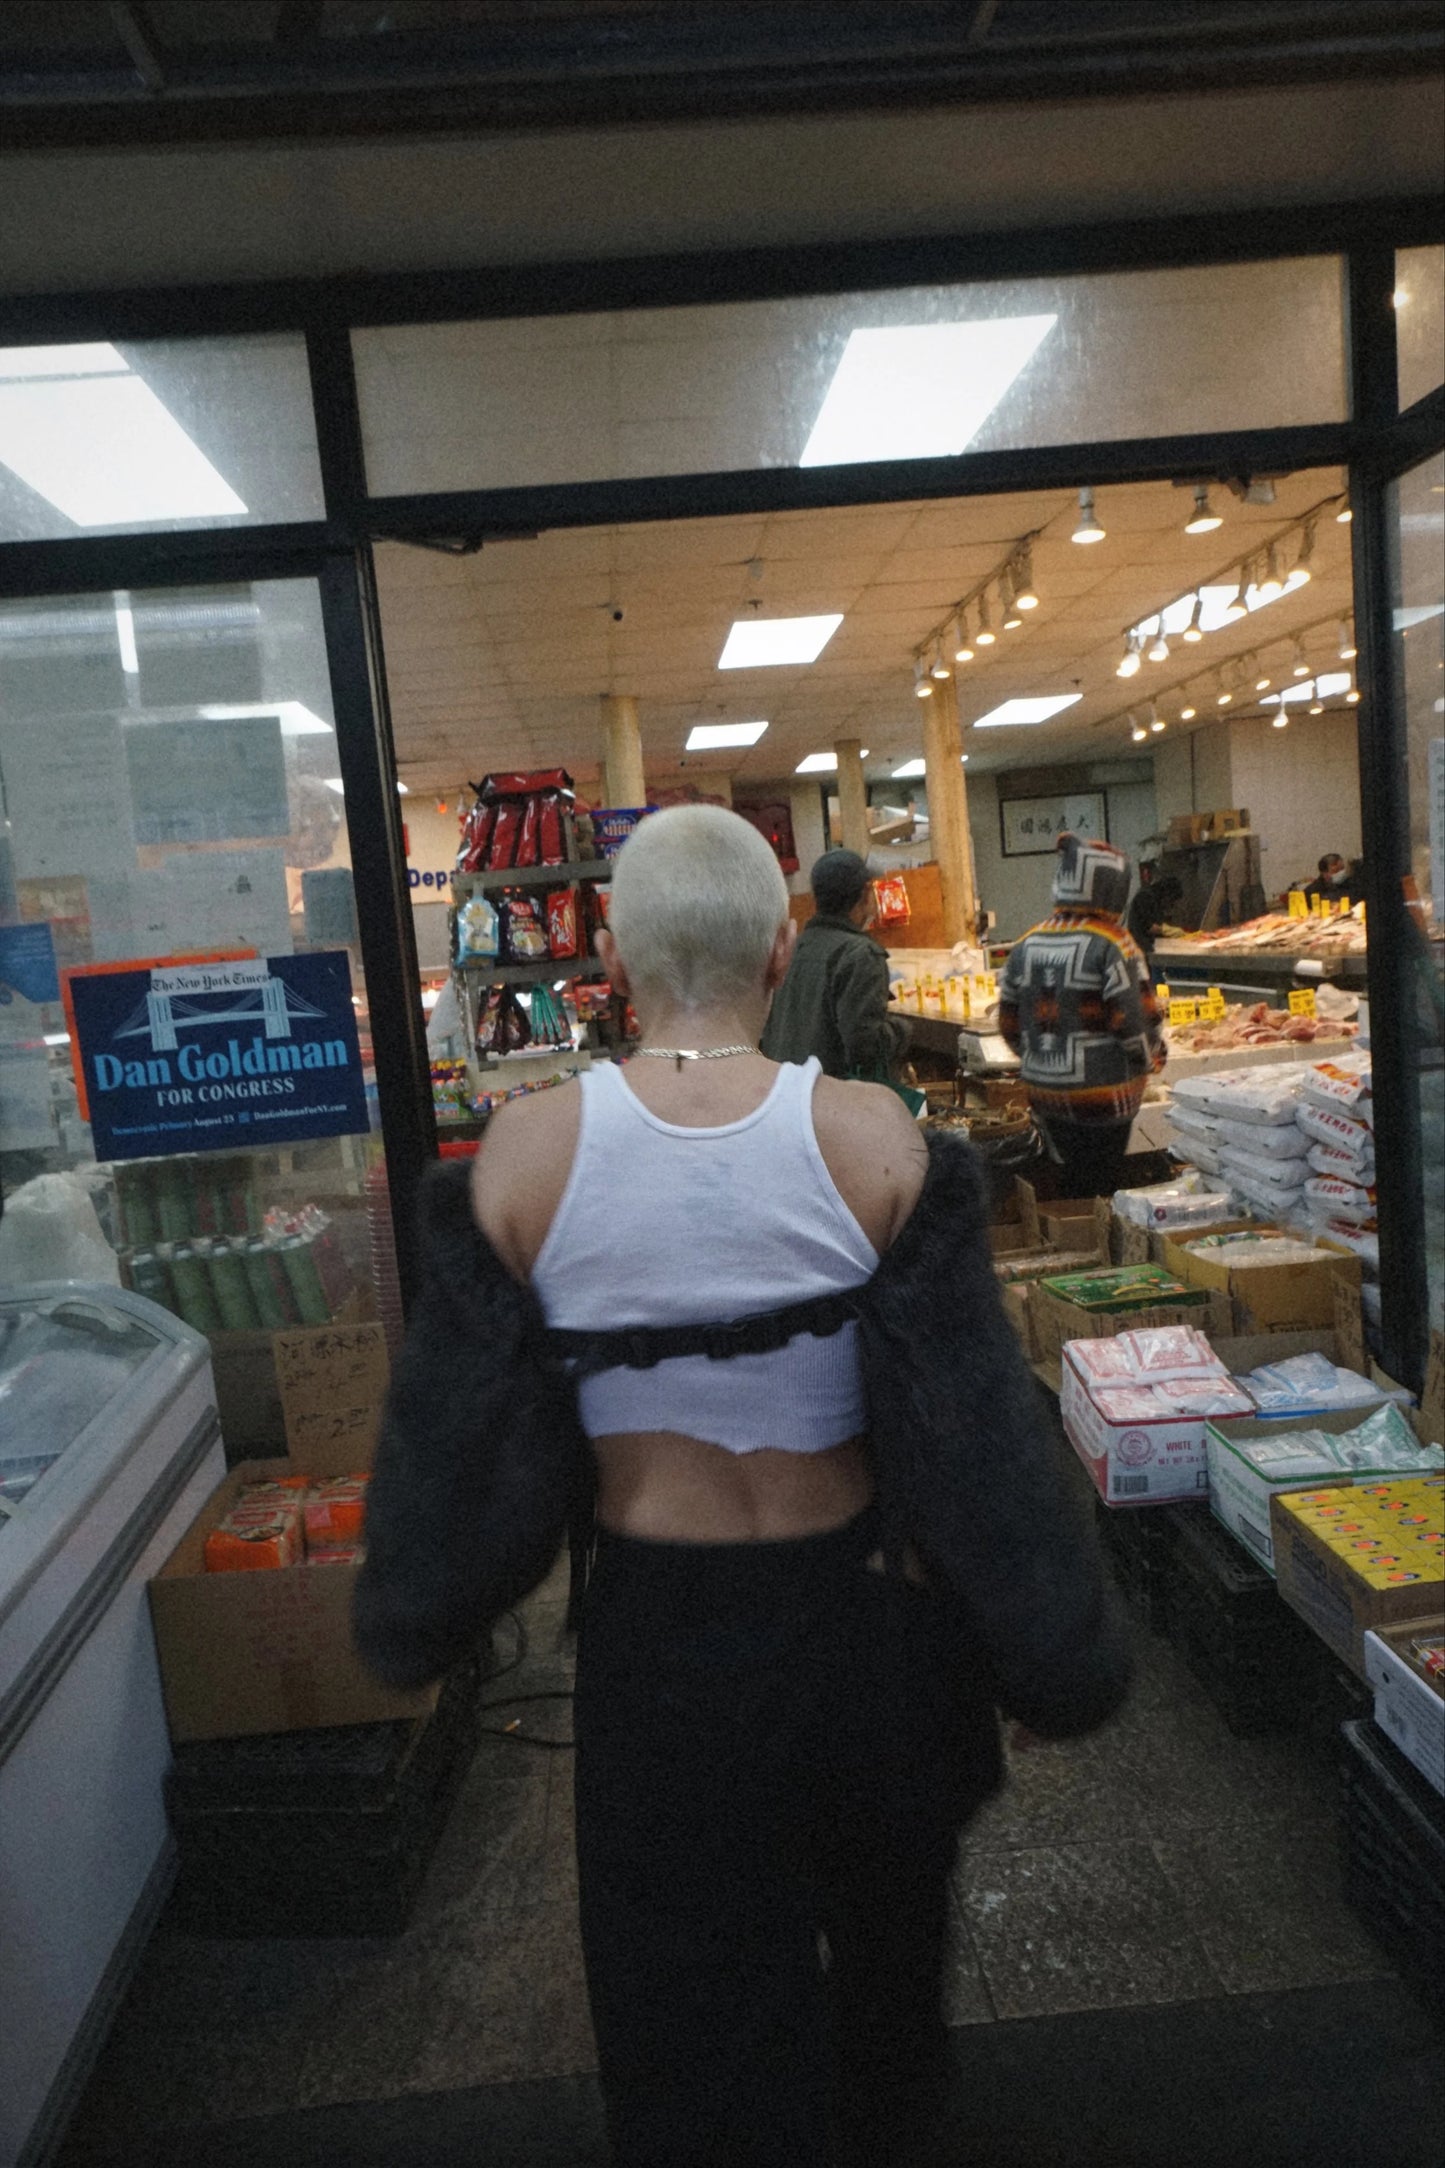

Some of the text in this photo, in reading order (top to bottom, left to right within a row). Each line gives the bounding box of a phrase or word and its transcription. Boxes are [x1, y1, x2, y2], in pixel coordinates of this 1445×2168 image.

[152, 972, 271, 992] The New York Times
[93, 1037, 349, 1091] Dan Goldman
[157, 1077, 296, 1107] FOR CONGRESS
[193, 1116, 222, 1128] August
[1166, 1440, 1193, 1451] WHITE
